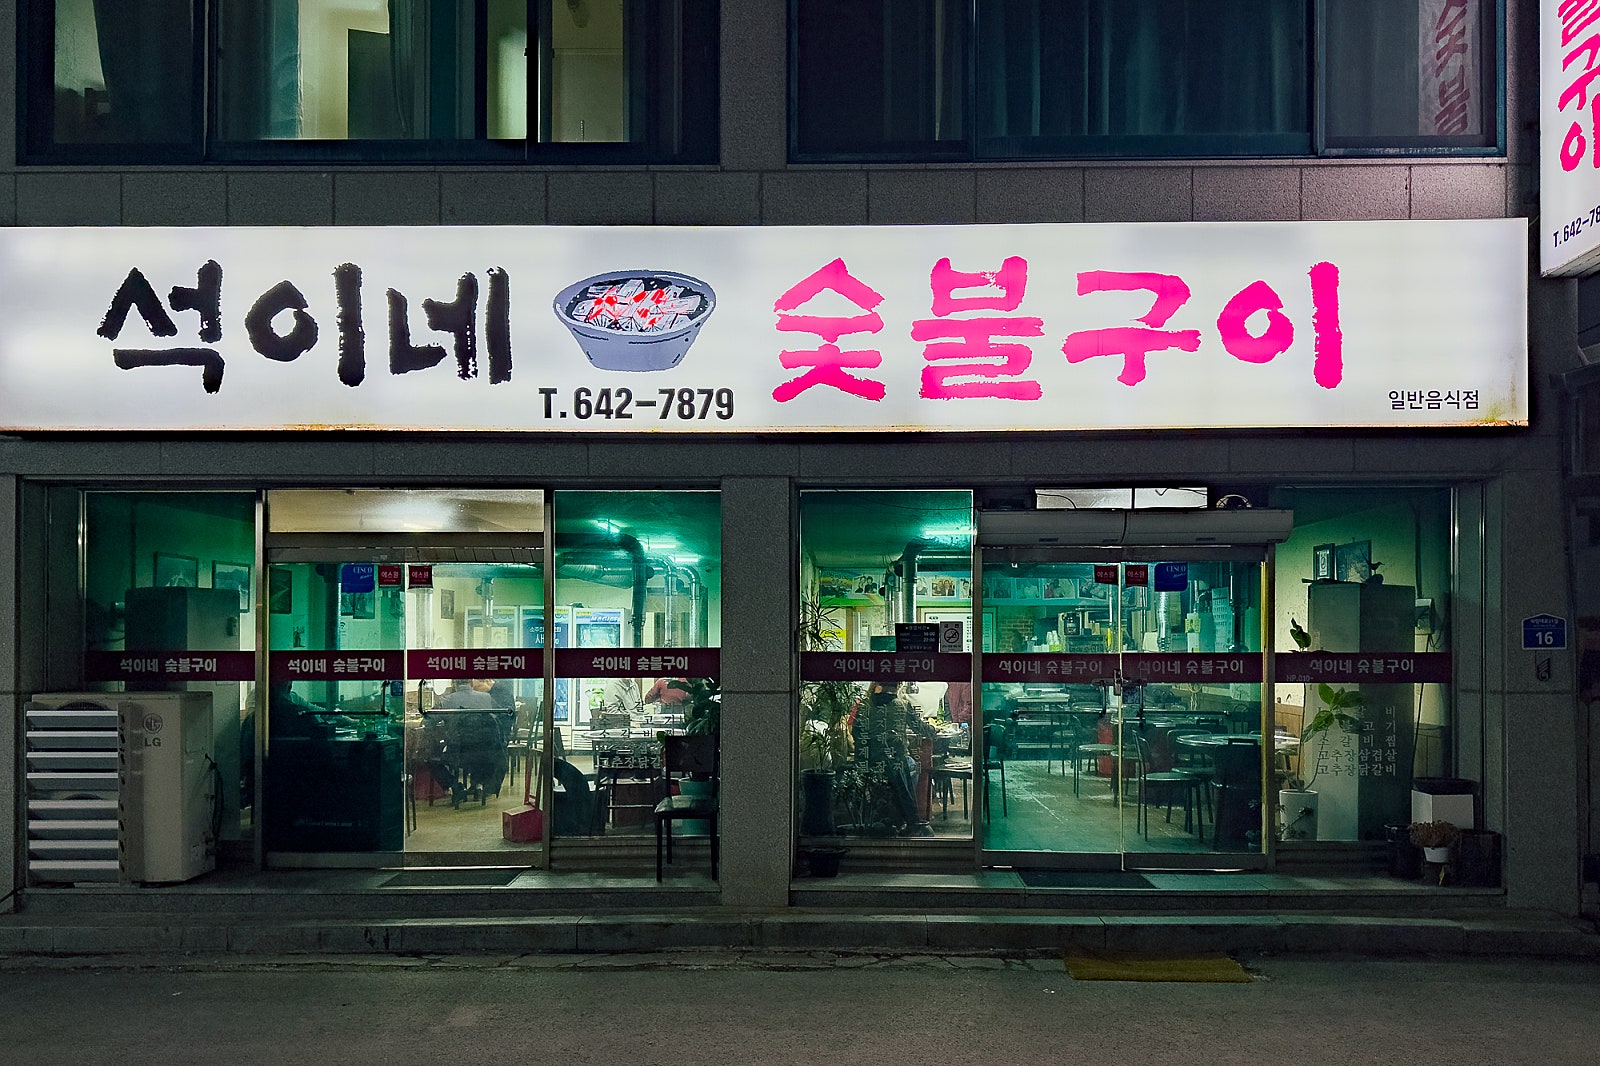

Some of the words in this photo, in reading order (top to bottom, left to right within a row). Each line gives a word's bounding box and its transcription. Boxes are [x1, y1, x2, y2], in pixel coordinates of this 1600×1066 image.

[97, 258, 512, 395] 석이네
[772, 256, 1344, 403] 숯불구이
[539, 387, 735, 421] T.642-7879
[1387, 388, 1480, 411] 일반음식점
[1535, 631, 1554, 645] 16
[120, 658, 159, 673] 석이네
[165, 658, 217, 673] 숯불구이
[287, 659, 327, 674] 석이네
[333, 658, 386, 673] 숯불구이
[426, 656, 467, 671] 석이네
[472, 656, 526, 671] 숯불구이
[591, 656, 631, 671] 석이네
[636, 656, 689, 671] 숯불구이
[833, 658, 875, 674] 석이네
[879, 658, 935, 674] 숯불구이
[998, 660, 1040, 675] 석이네
[1046, 660, 1103, 675] 숯불구이
[1136, 660, 1180, 675] 석이네
[1186, 659, 1241, 675] 숯불구이
[1309, 659, 1352, 674] 석이네
[1357, 659, 1414, 674] 숯불구이
[145, 737, 162, 747] LG
[1318, 748, 1397, 762] 고추장삼겹살
[1318, 763, 1396, 777] 고추장닭갈비
